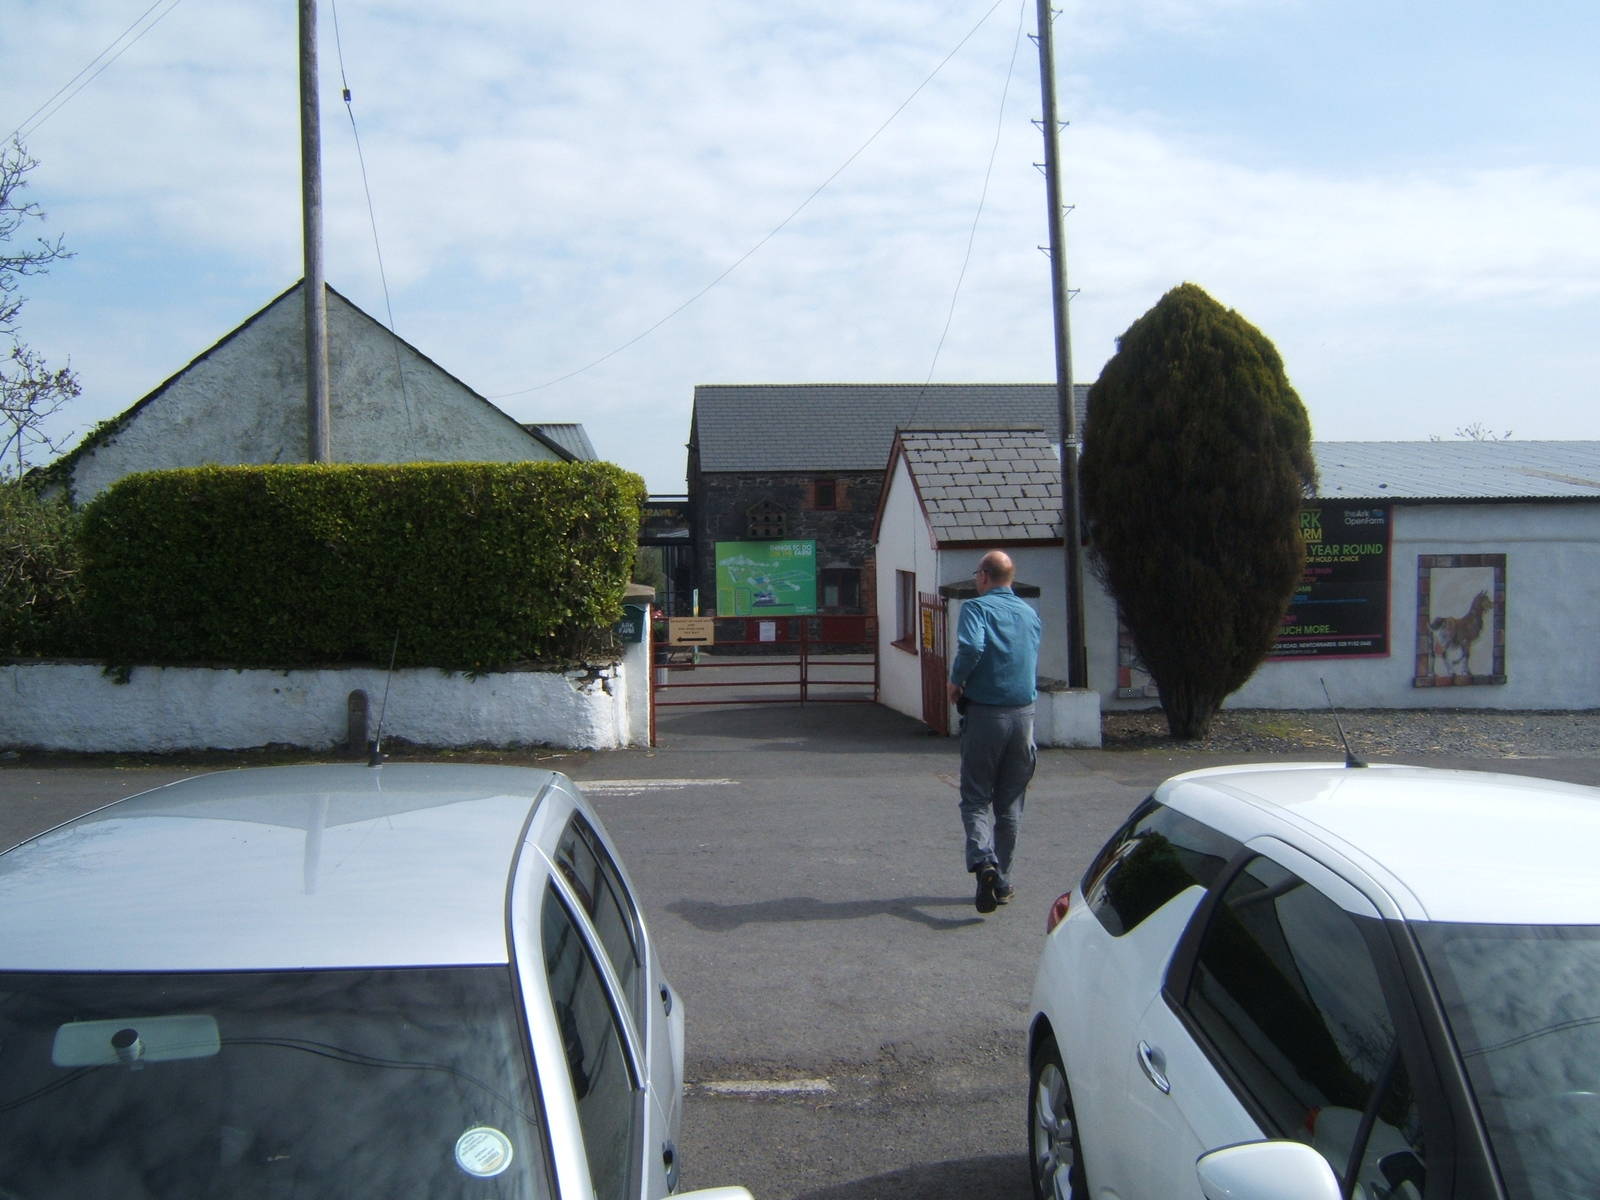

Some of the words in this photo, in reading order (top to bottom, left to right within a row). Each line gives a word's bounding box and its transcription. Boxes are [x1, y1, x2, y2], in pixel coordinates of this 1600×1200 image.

[1300, 512, 1321, 528] RK
[1310, 544, 1340, 556] YEAR
[1342, 543, 1384, 555] ROUND
